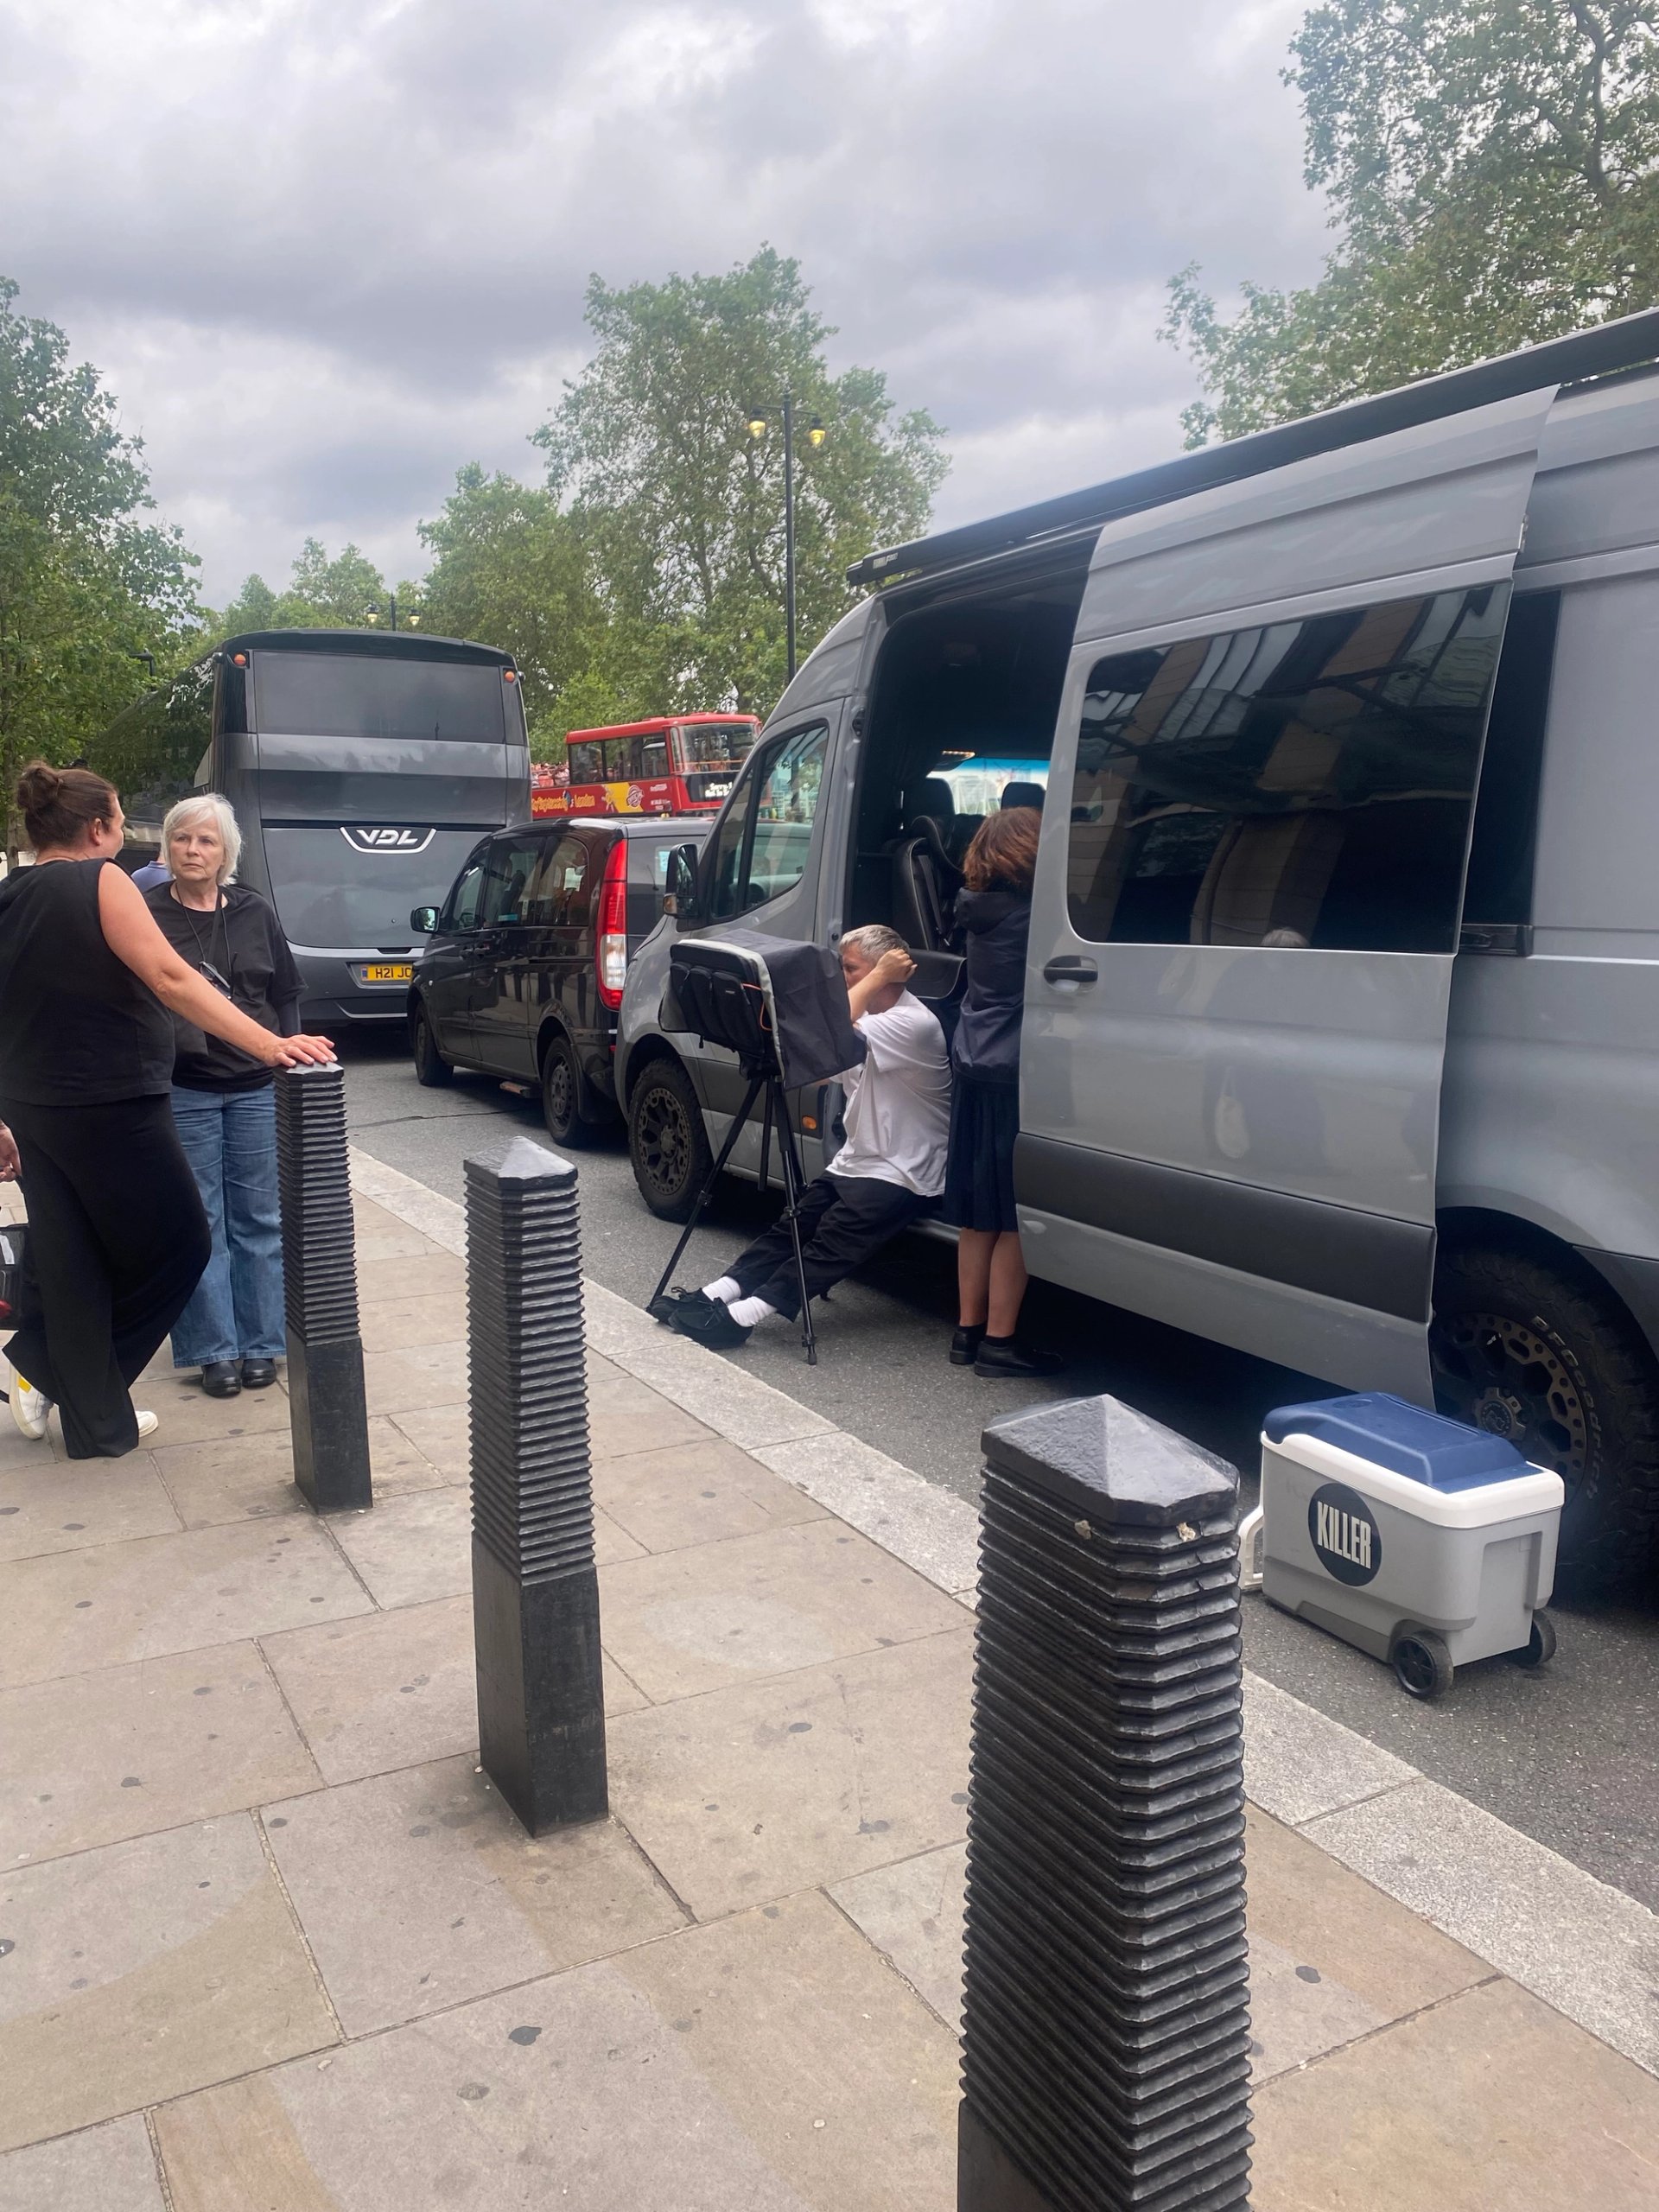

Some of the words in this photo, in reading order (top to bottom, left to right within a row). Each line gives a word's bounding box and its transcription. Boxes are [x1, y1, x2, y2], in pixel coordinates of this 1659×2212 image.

[575, 793, 595, 808] London
[356, 830, 418, 845] VDL
[1318, 1501, 1371, 1569] KILLER
